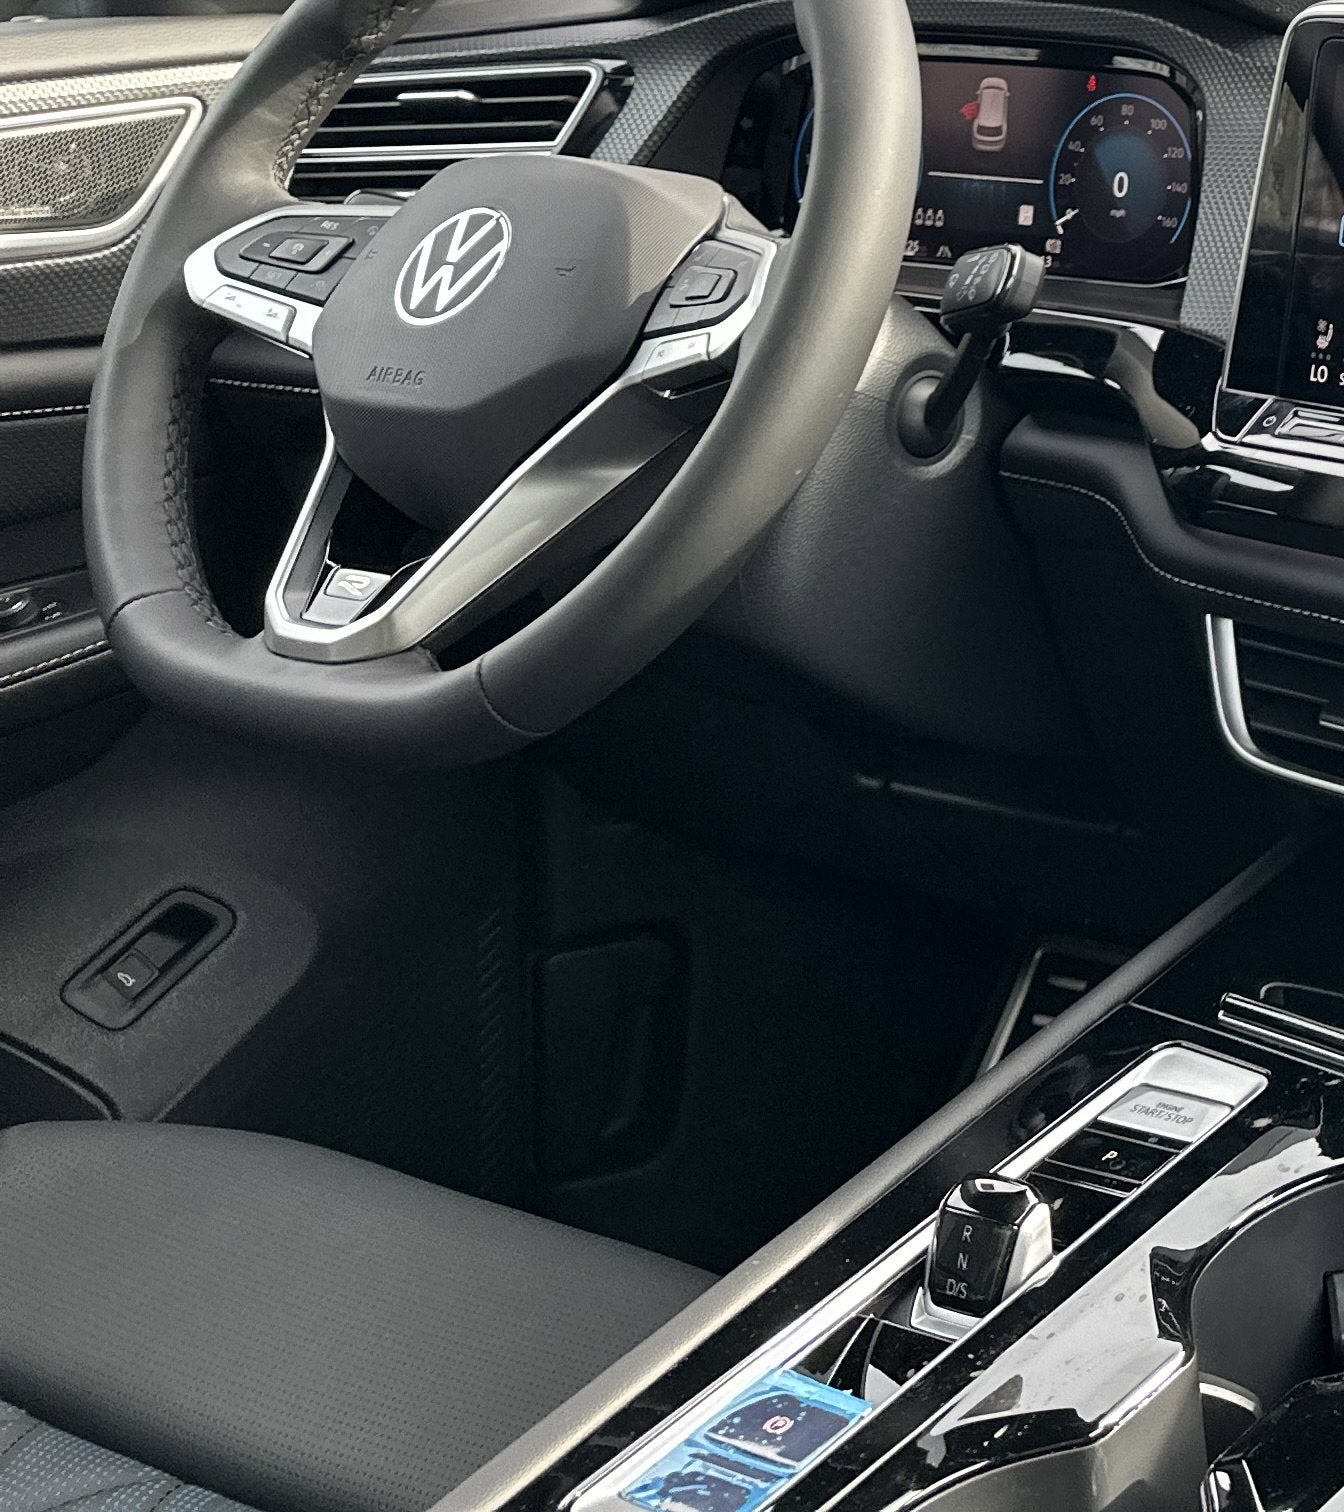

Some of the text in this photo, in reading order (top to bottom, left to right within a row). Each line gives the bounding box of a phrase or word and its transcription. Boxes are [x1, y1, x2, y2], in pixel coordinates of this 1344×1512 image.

[1121, 104, 1134, 116] 80
[1090, 115, 1104, 126] 60
[1150, 118, 1168, 130] 100
[1167, 147, 1184, 159] 120
[1113, 171, 1129, 198] 0
[1171, 182, 1188, 193] 140
[1161, 216, 1178, 228] 160
[366, 365, 426, 386] AIRBAG
[1309, 363, 1329, 383] LO
[1155, 1101, 1185, 1113] ENGINE
[1129, 1103, 1194, 1125] START/STOP
[1101, 1150, 1119, 1161] P
[961, 1224, 974, 1243] R
[957, 1252, 970, 1271] N
[945, 1278, 969, 1299] D/S
